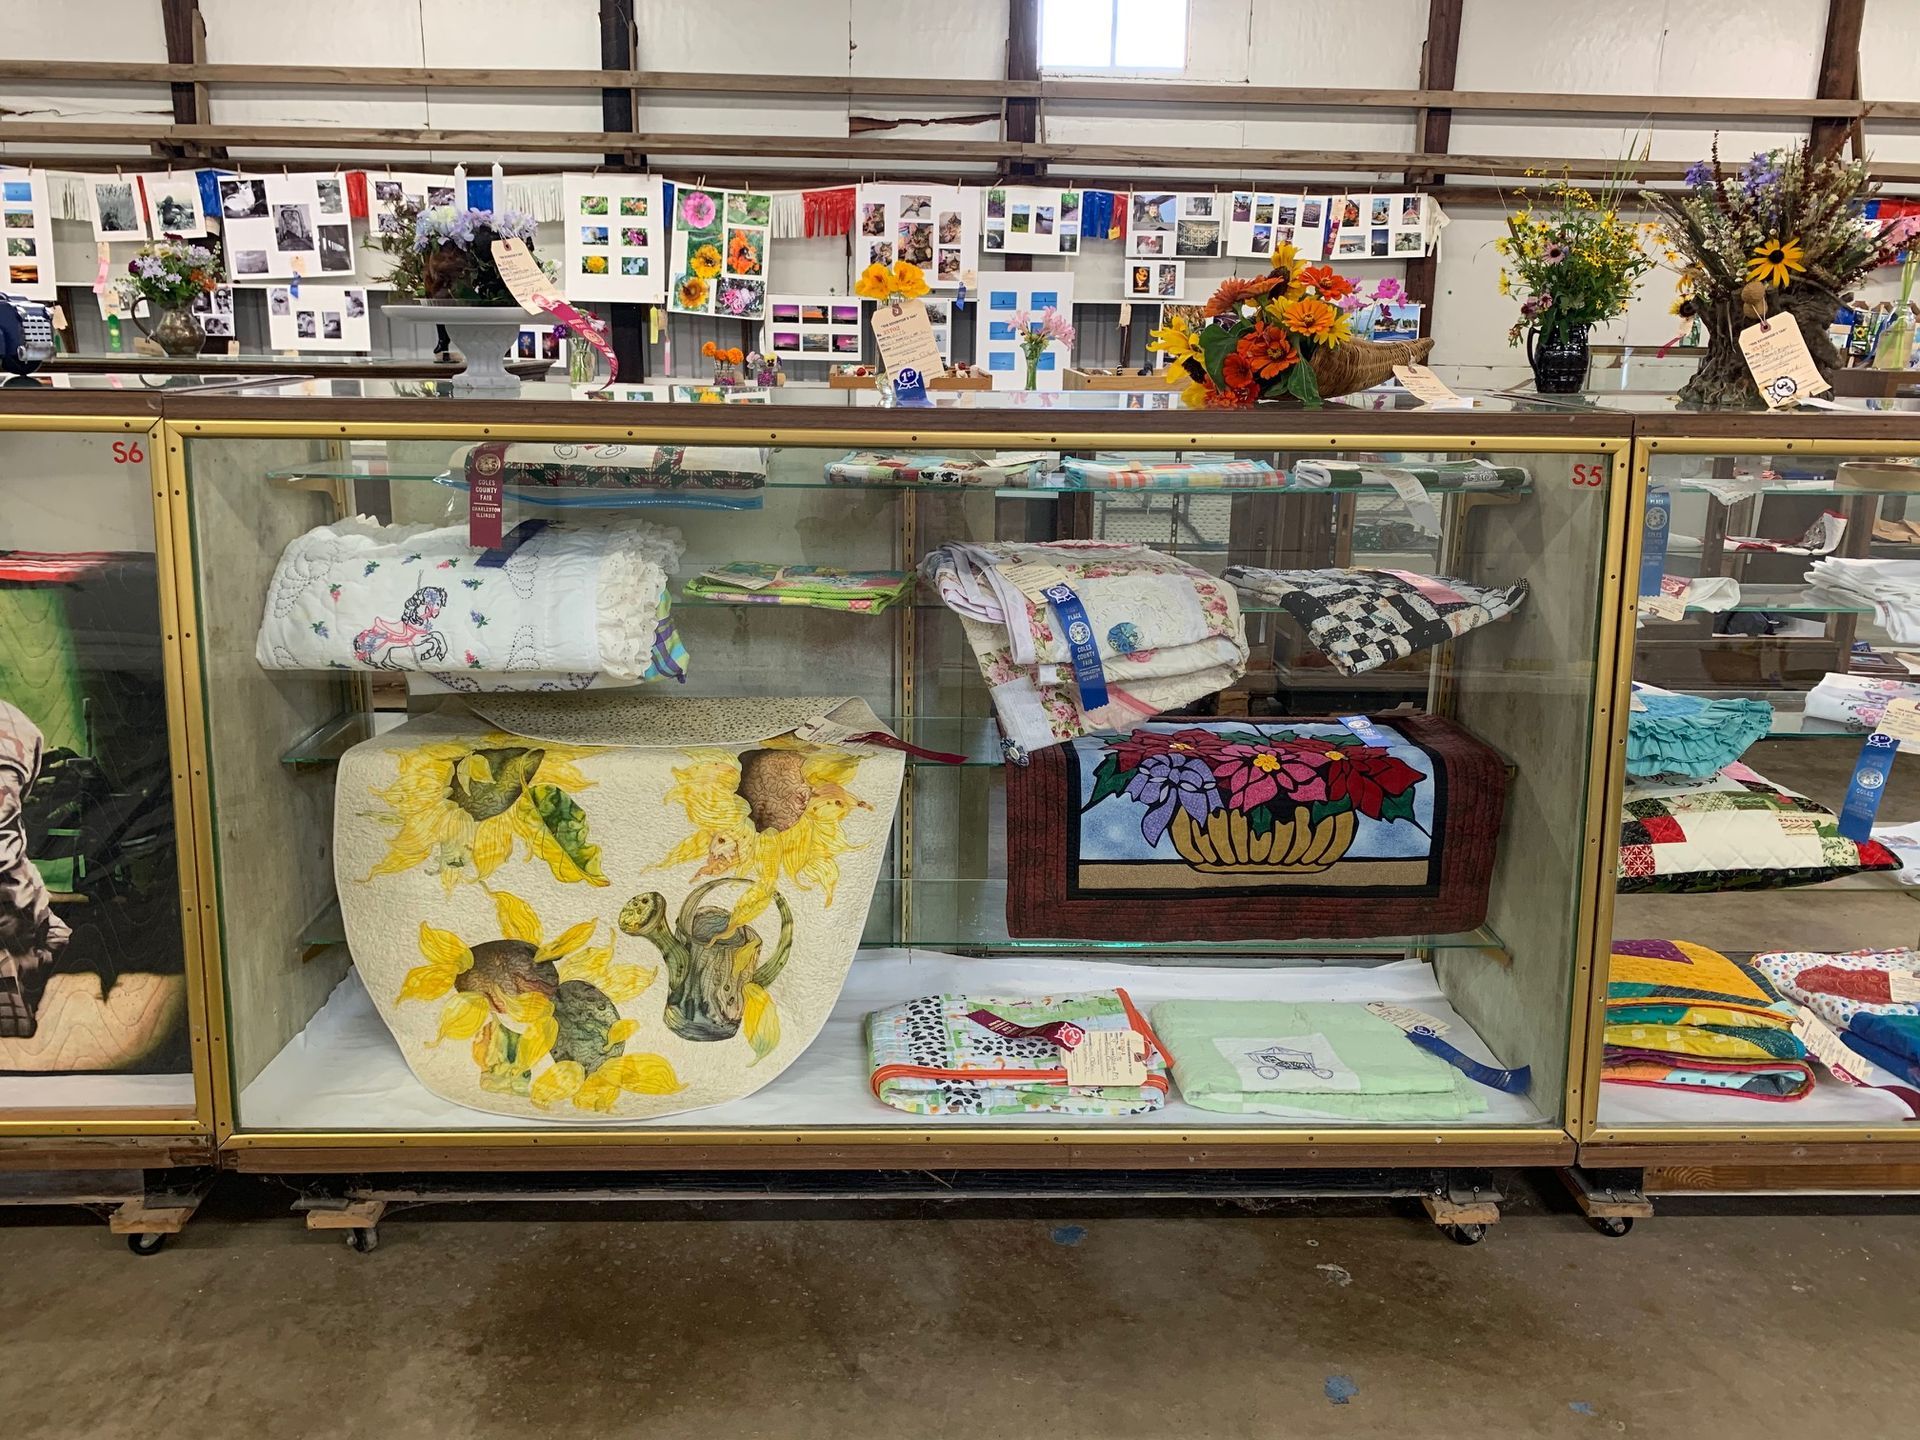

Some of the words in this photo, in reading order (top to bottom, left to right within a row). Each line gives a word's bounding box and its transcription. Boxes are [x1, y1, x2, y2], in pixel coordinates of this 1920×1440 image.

[900, 370, 915, 383] 1ST
[112, 441, 144, 464] S6
[1572, 464, 1603, 487] S5
[1077, 645, 1092, 653] COLES
[1077, 652, 1096, 661] COUNTY
[1082, 659, 1093, 667] FAIR
